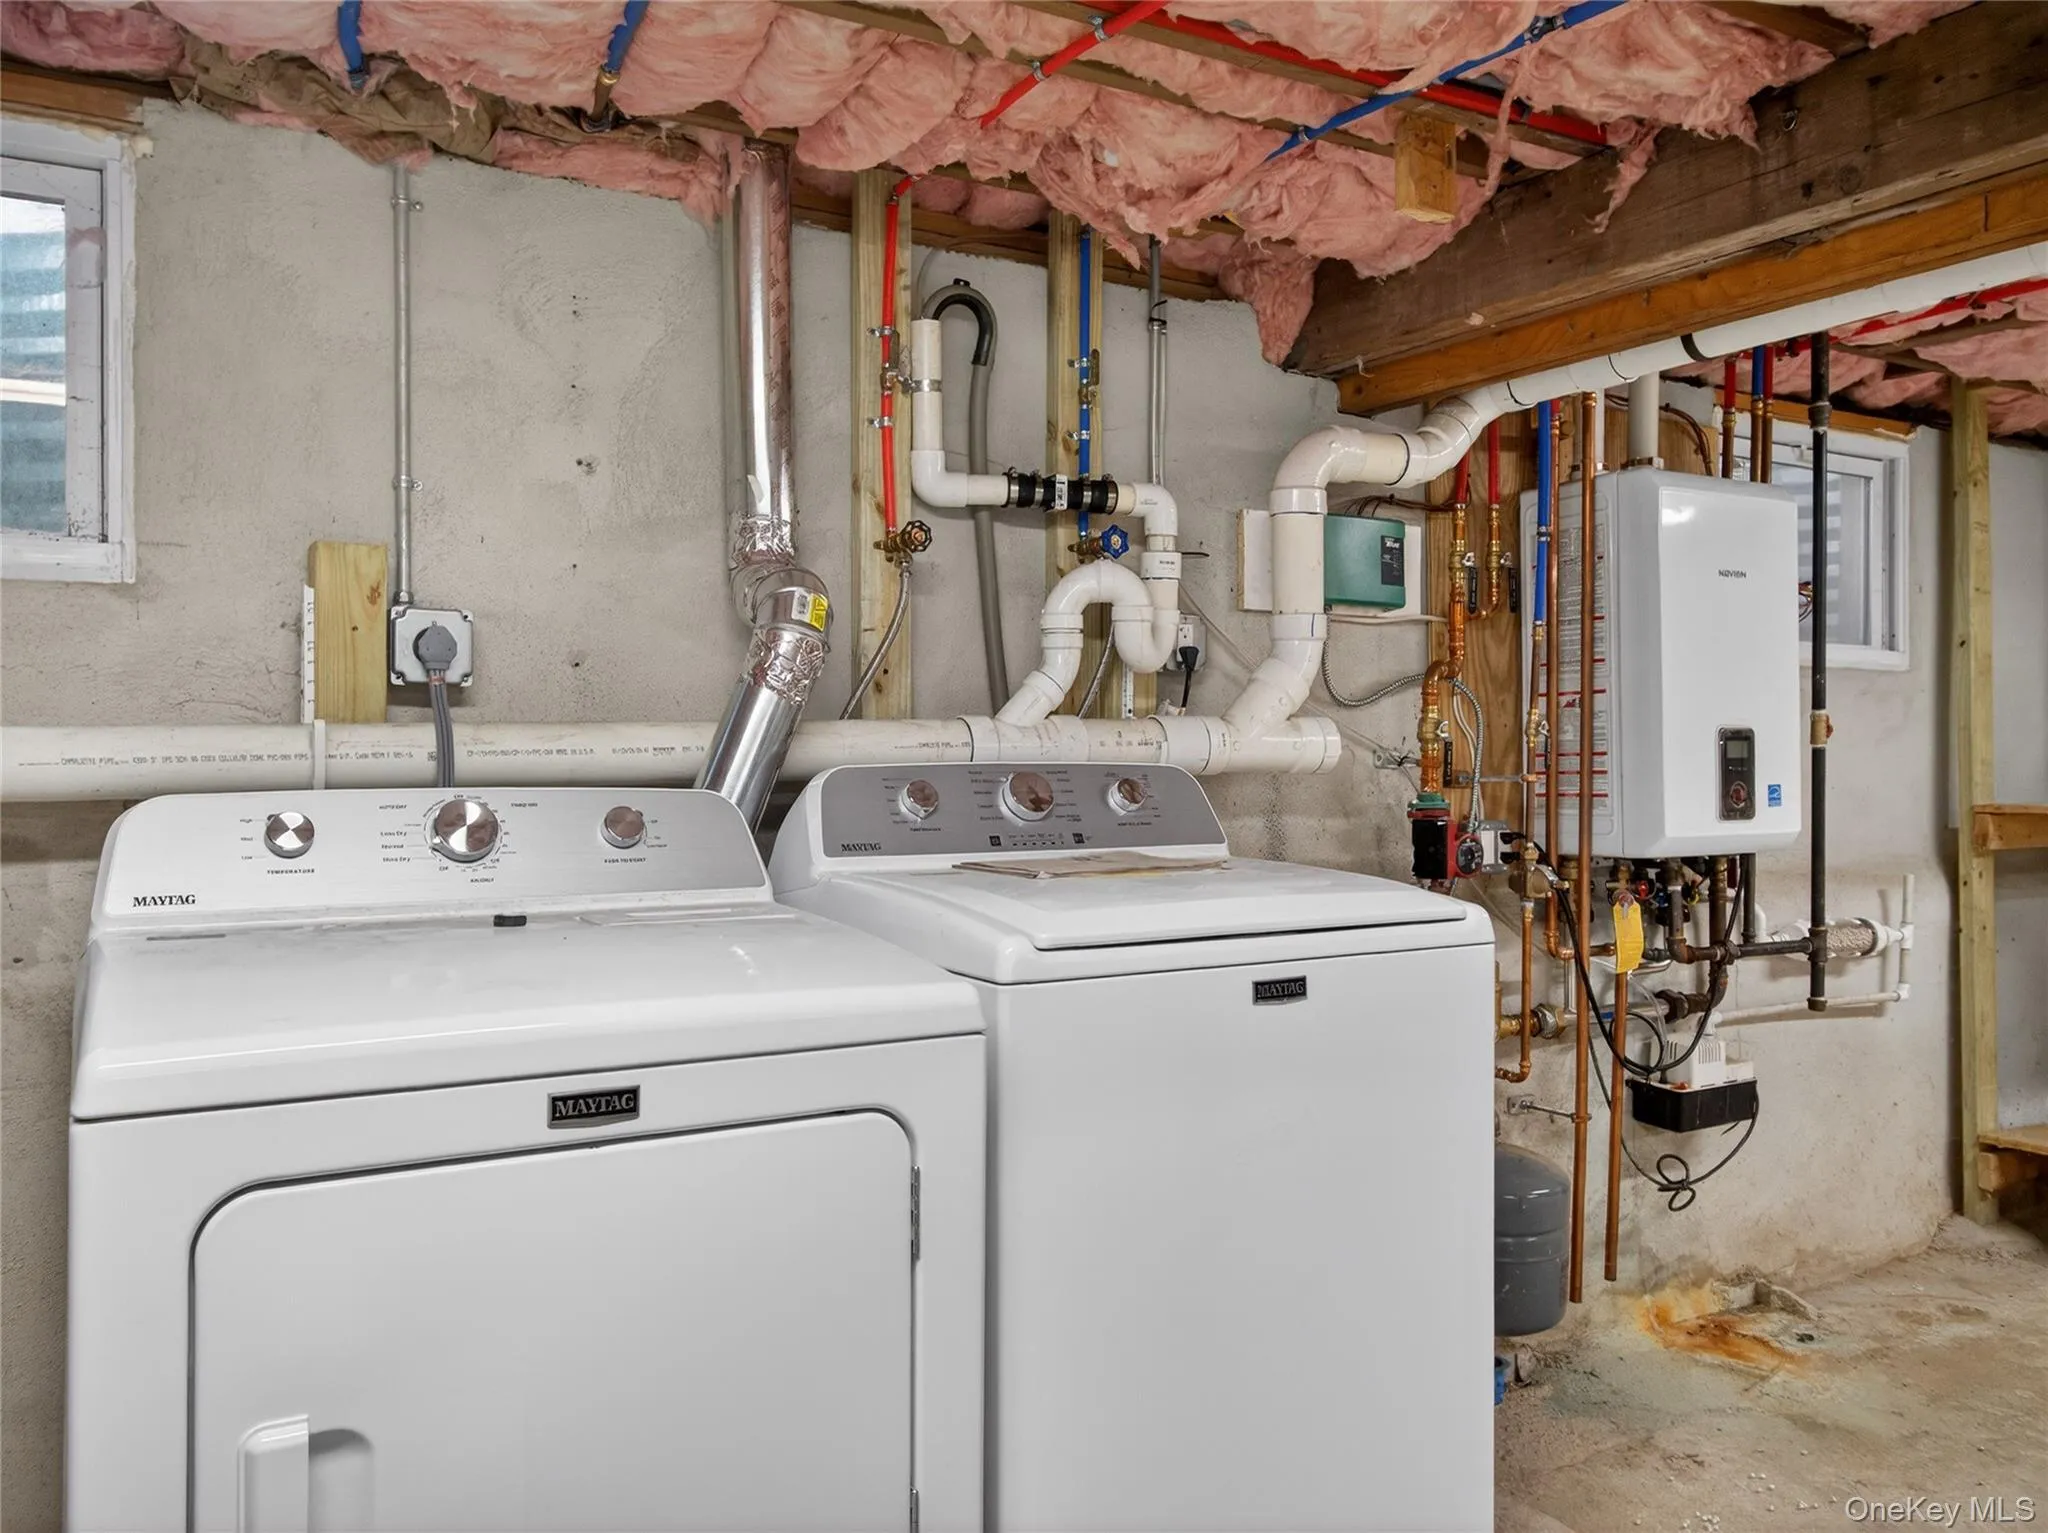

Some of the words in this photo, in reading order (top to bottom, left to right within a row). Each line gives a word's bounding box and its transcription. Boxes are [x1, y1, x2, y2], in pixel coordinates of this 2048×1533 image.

[841, 843, 881, 852] MAYTAG
[133, 894, 196, 907] MAYTAG
[1257, 981, 1304, 998] MAYTAG
[555, 1094, 634, 1117] MAYTAG
